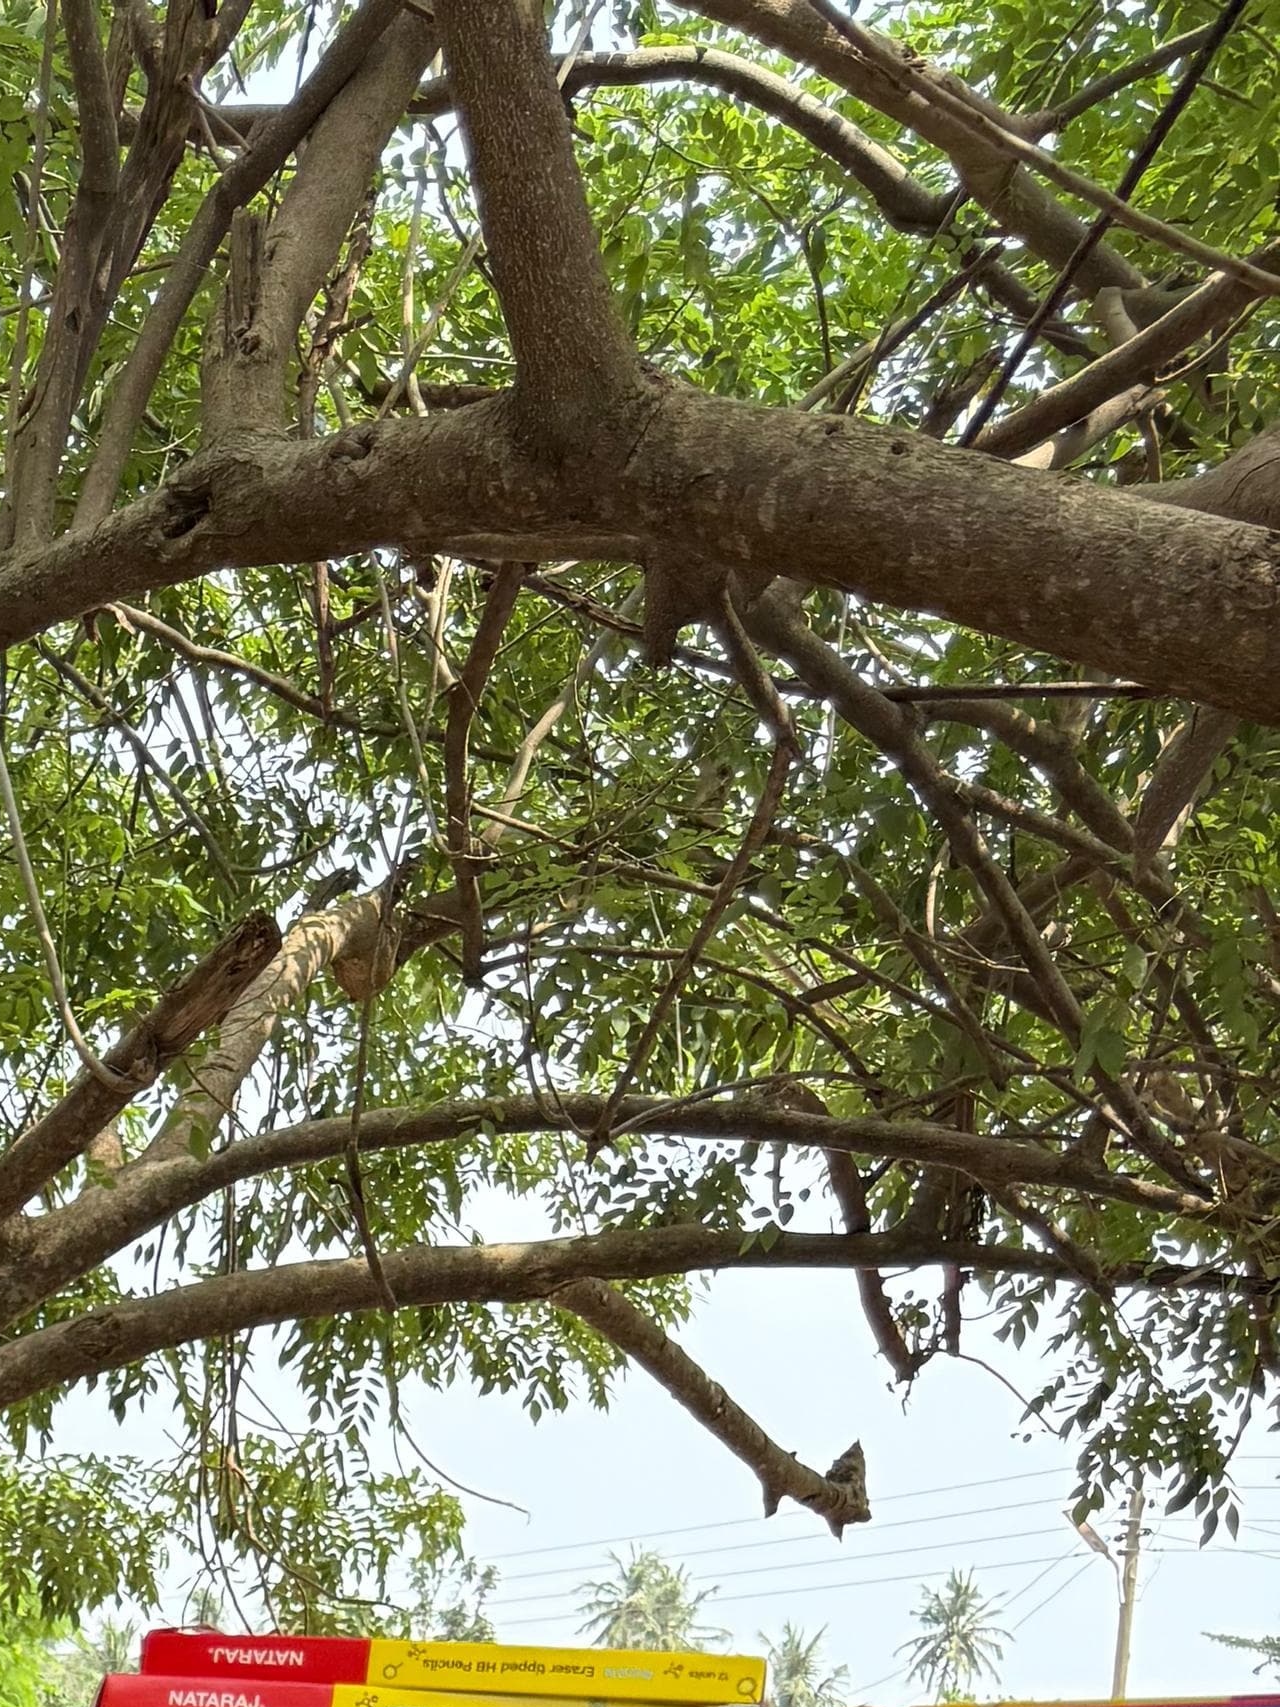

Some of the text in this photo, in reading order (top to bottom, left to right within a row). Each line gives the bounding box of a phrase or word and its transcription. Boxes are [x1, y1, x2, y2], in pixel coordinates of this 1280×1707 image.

[422, 1658, 472, 1672] Pencils
[476, 1661, 496, 1673] HB
[500, 1660, 545, 1675] tipped
[549, 1665, 595, 1678] Eraser
